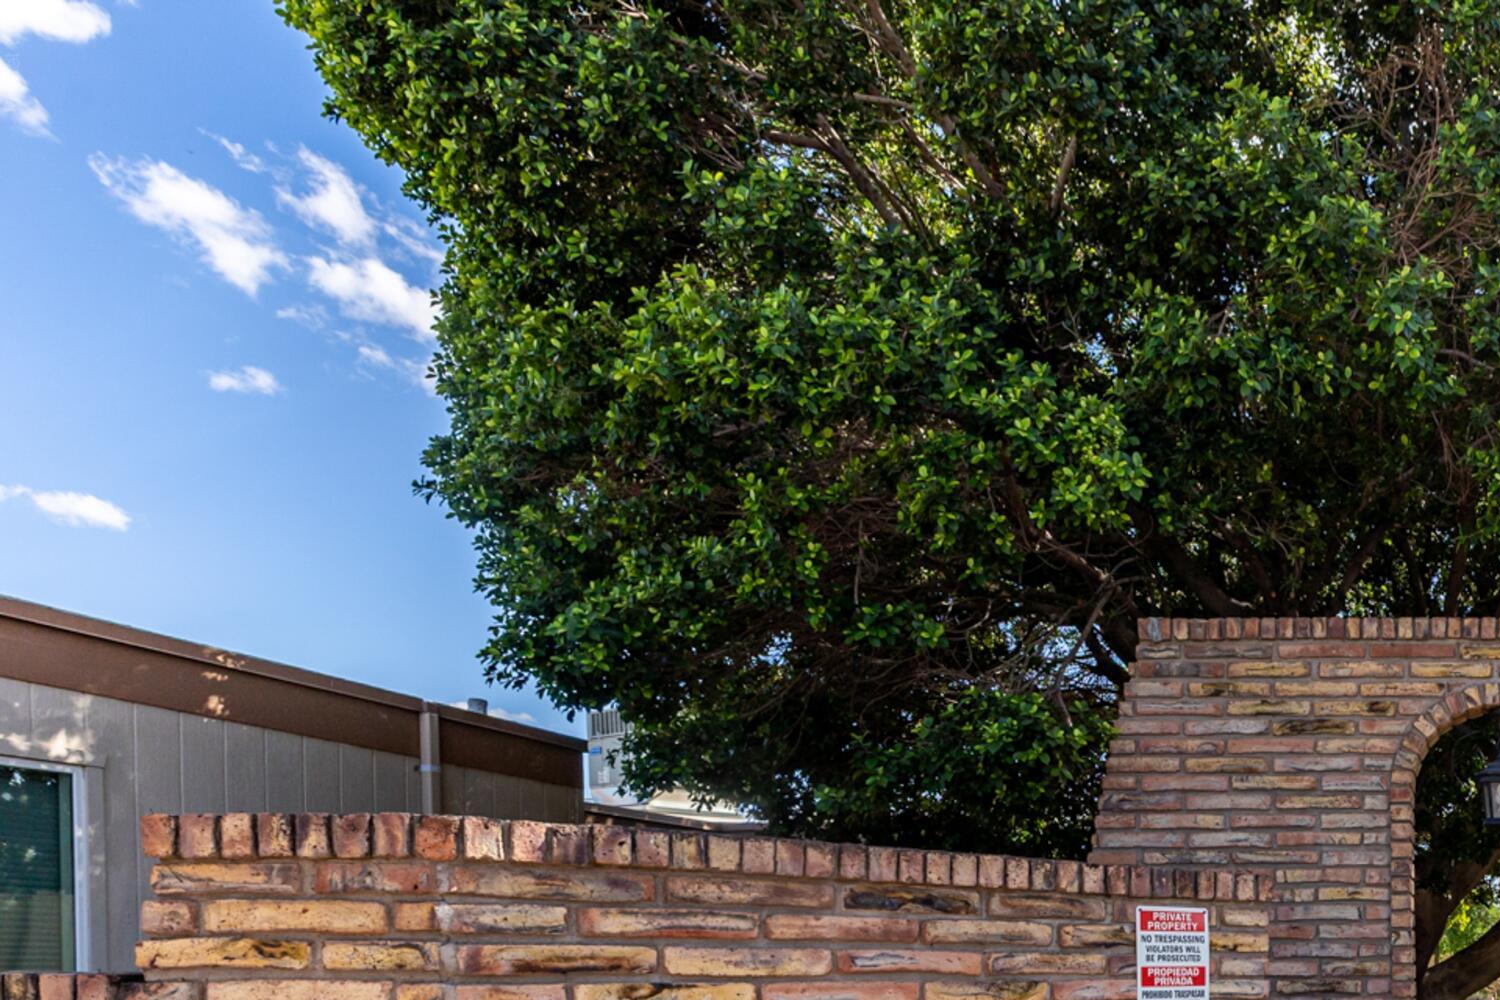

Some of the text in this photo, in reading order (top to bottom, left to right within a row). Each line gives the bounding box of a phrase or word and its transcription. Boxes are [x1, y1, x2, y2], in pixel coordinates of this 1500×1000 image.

[1153, 911, 1192, 921] PRIVATE
[1147, 921, 1199, 931] PROPERTY
[1141, 935, 1205, 944] NO TRESPASSING
[1145, 945, 1201, 954] VIOLATORS WILL
[1147, 967, 1200, 977] PROPIEDAD
[1154, 976, 1194, 986] PRIVADA
